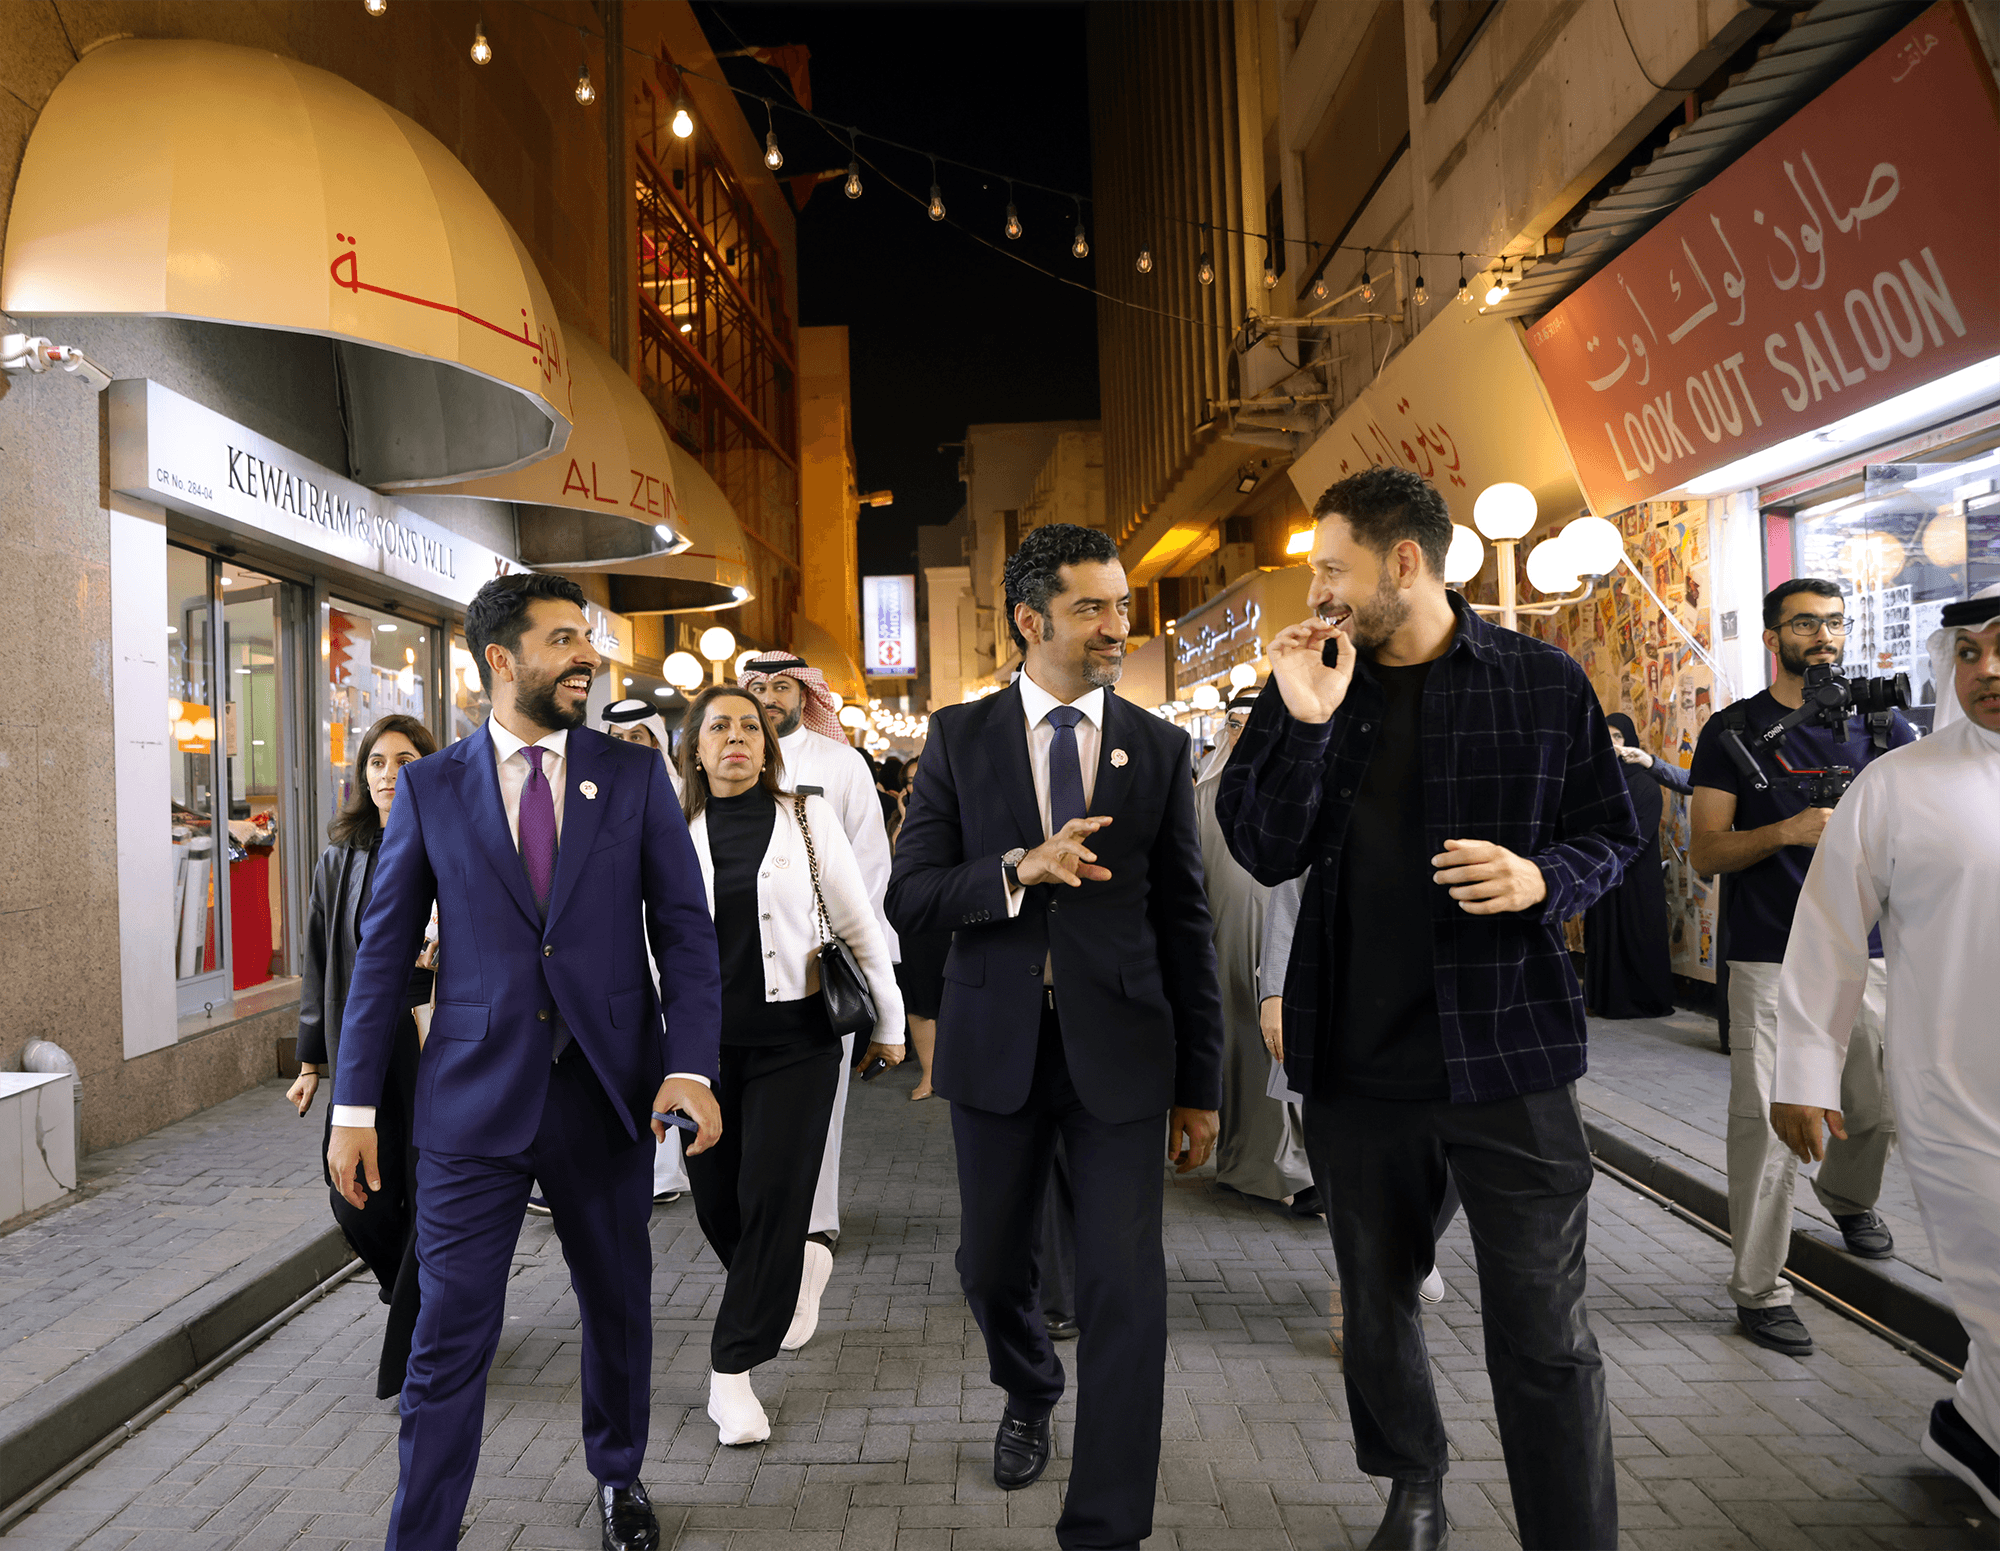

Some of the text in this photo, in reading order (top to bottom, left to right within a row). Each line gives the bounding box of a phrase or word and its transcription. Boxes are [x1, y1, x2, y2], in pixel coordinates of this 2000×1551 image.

[1586, 149, 1900, 391] صالون لوك أوت
[1605, 246, 1967, 482] LOOK OUT SALOON
[156, 468, 213, 501] CR No. 284-04
[227, 445, 352, 538] KEWALRAM
[355, 506, 375, 549] &
[373, 515, 417, 564] SONS
[562, 458, 619, 505] AL
[889, 583, 900, 638] MIDWAY
